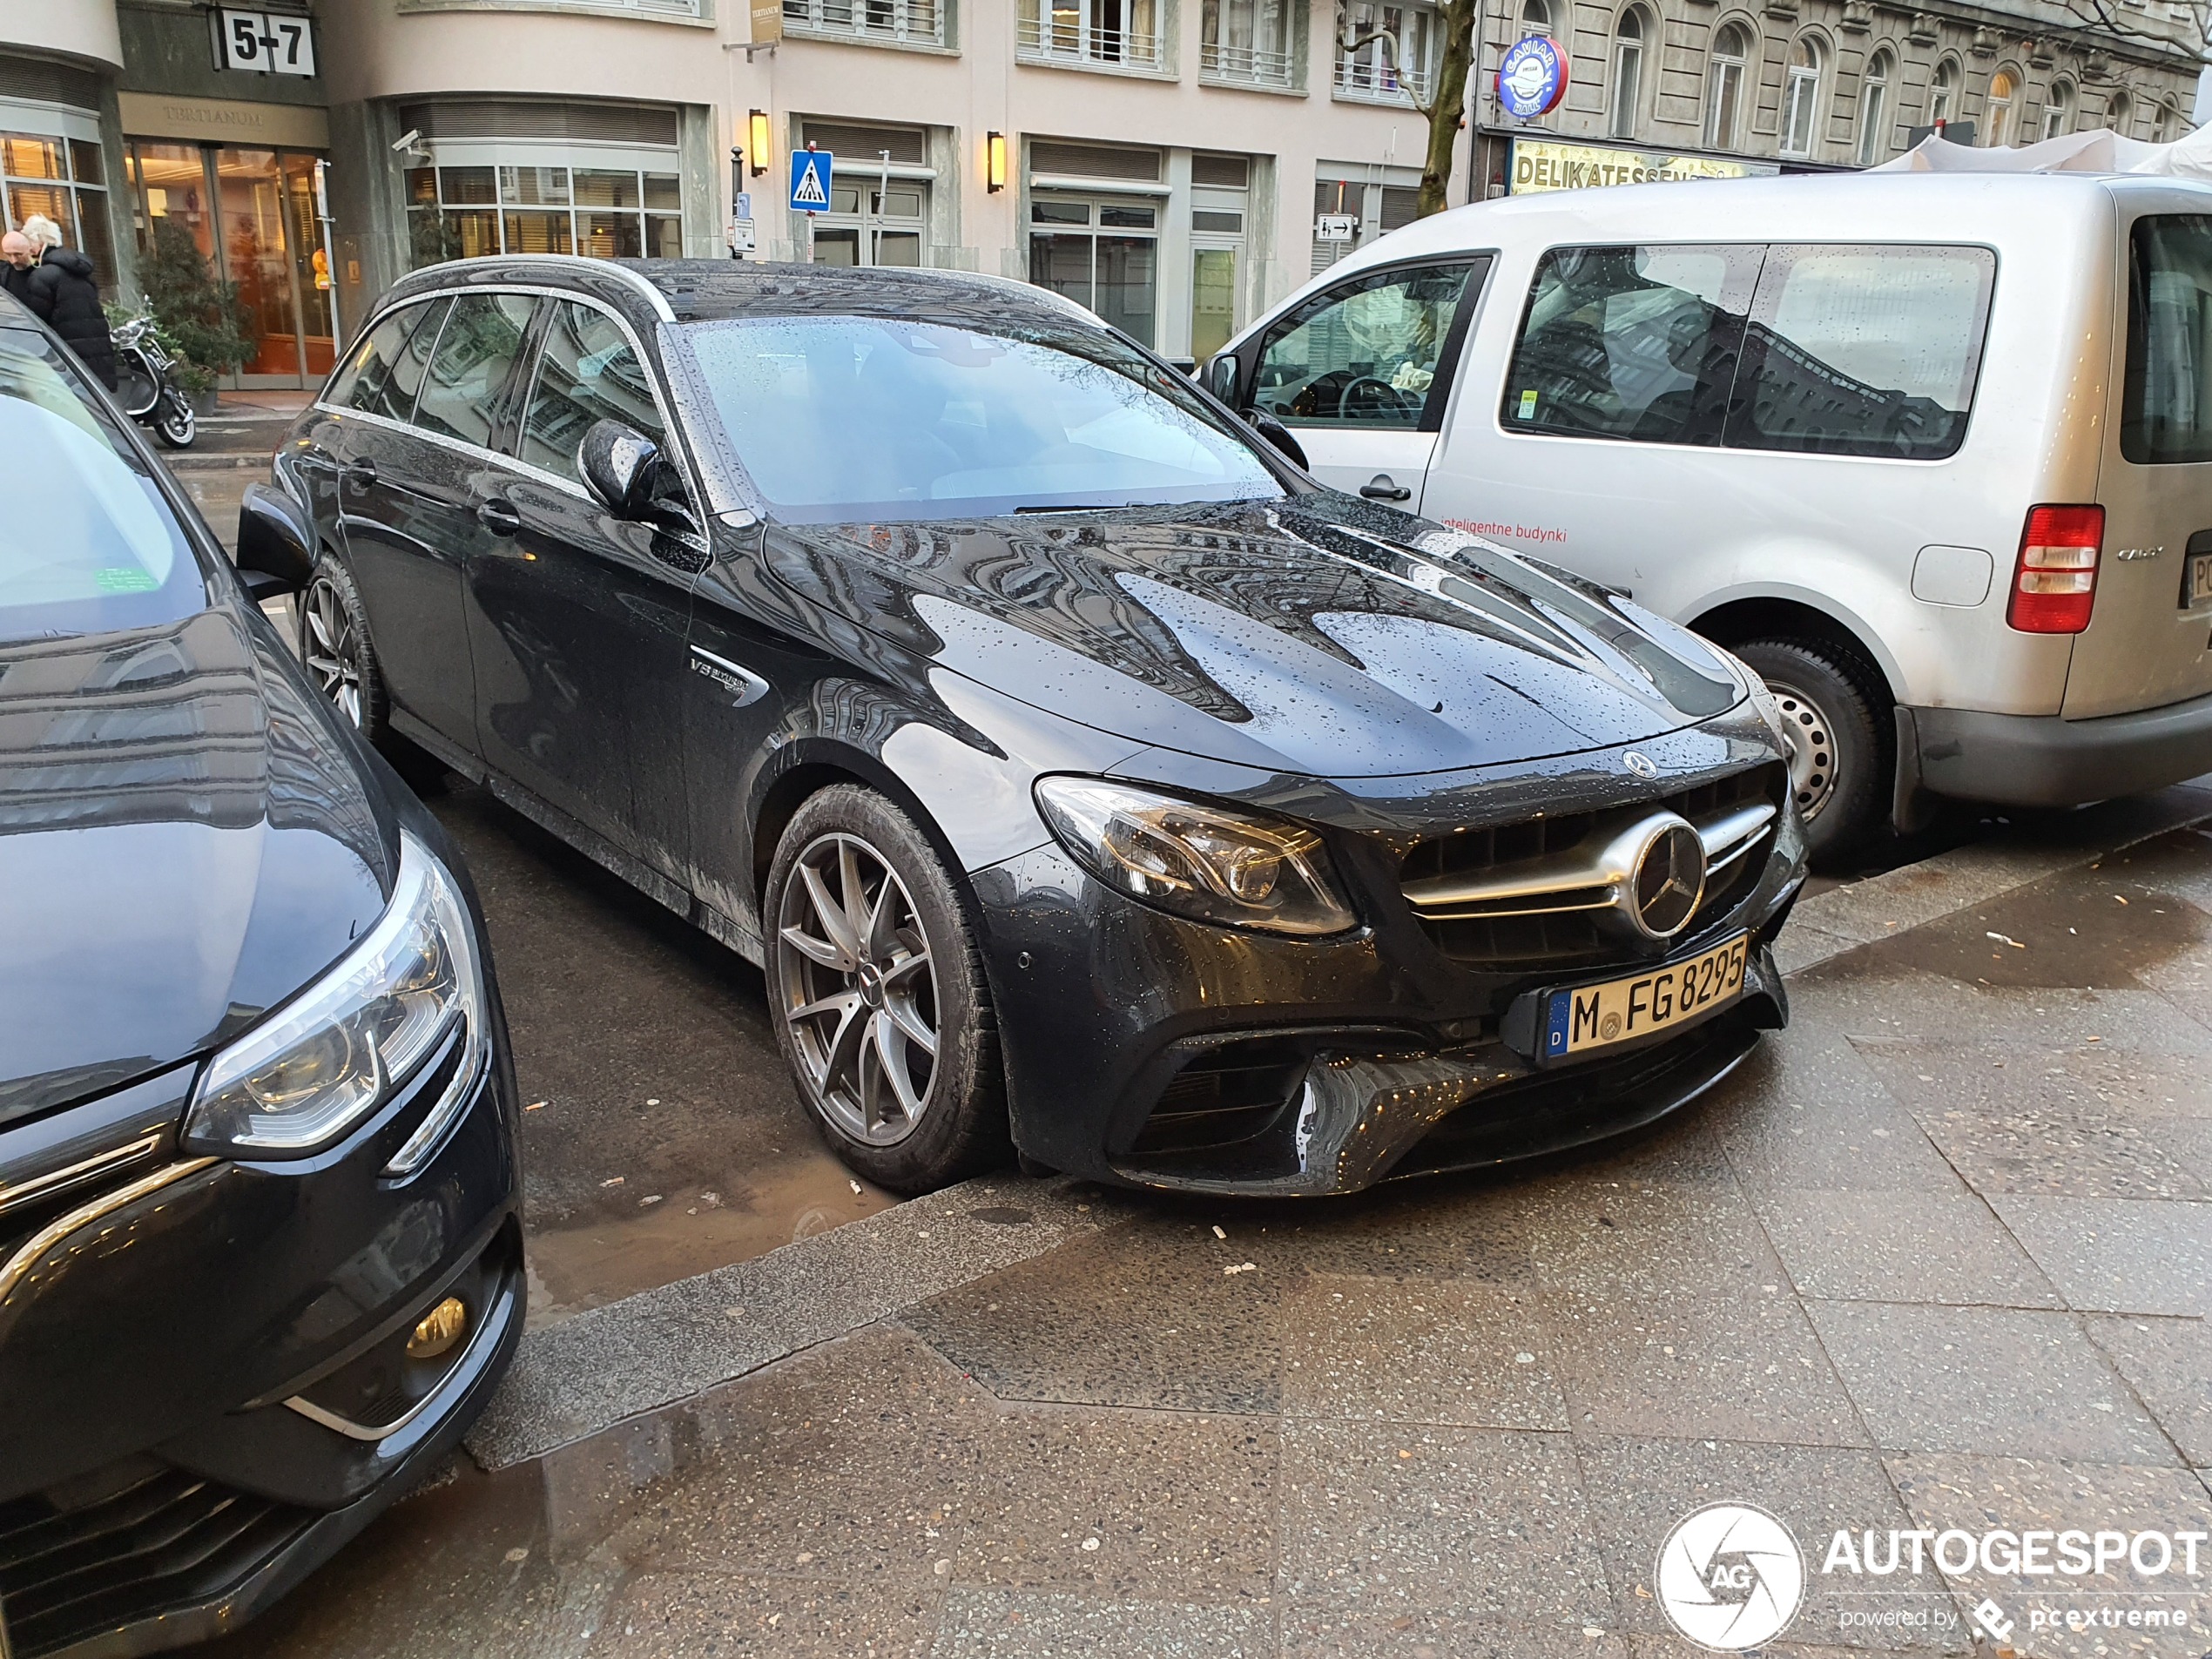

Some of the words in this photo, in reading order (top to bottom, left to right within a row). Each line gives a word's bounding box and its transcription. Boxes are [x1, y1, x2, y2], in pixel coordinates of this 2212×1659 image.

[1506, 40, 1554, 73] CAVIAR
[163, 106, 263, 126] TERTIANUM
[1513, 102, 1541, 115] HALL
[1440, 516, 1512, 536] inteligentne
[1516, 523, 1567, 543] budynki
[691, 658, 718, 677] V8
[712, 668, 749, 690] BITURBO
[1573, 991, 1600, 1043] M
[1627, 974, 1673, 1030] FG
[1680, 941, 1744, 1011] 8295
[1551, 1031, 1561, 1046] D
